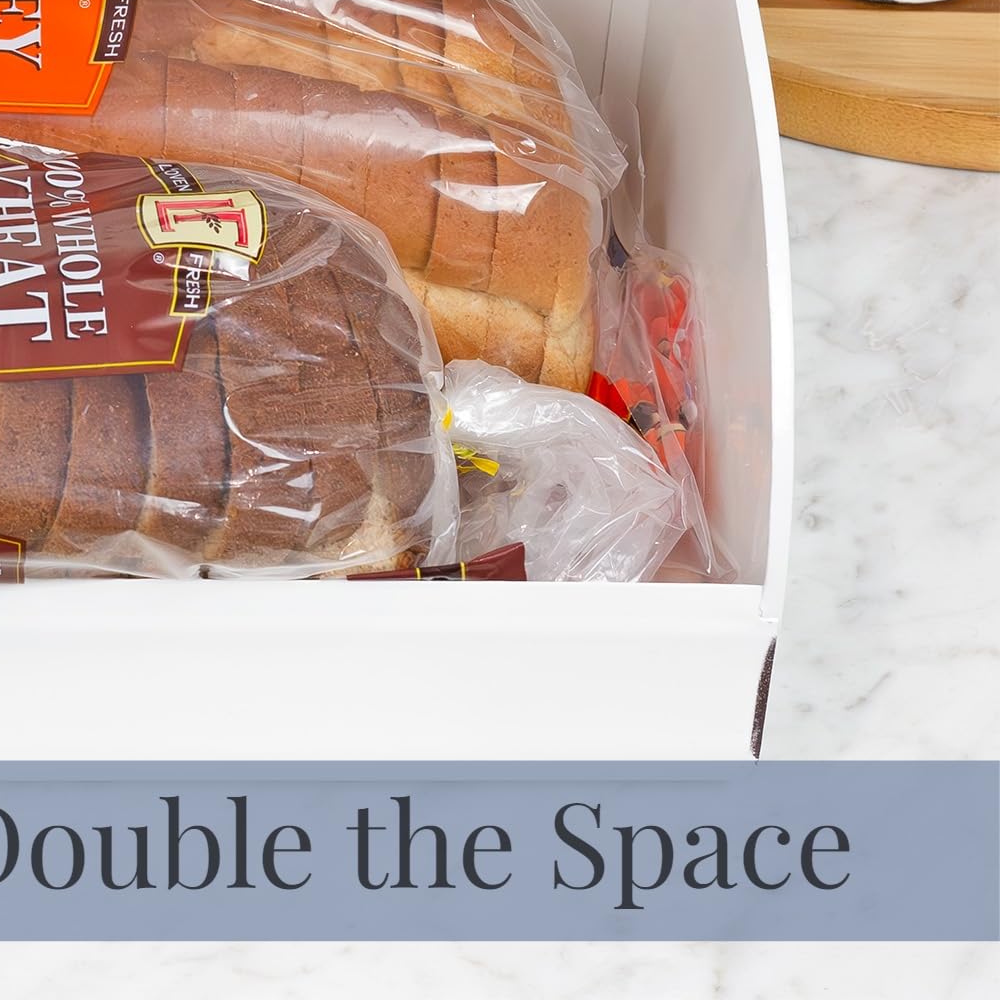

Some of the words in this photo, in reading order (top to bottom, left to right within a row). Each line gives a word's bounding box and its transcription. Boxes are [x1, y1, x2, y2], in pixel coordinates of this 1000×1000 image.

[50, 208, 108, 339] WHOLE
[158, 163, 192, 191] L'OVEN
[183, 252, 202, 308] FRESH
